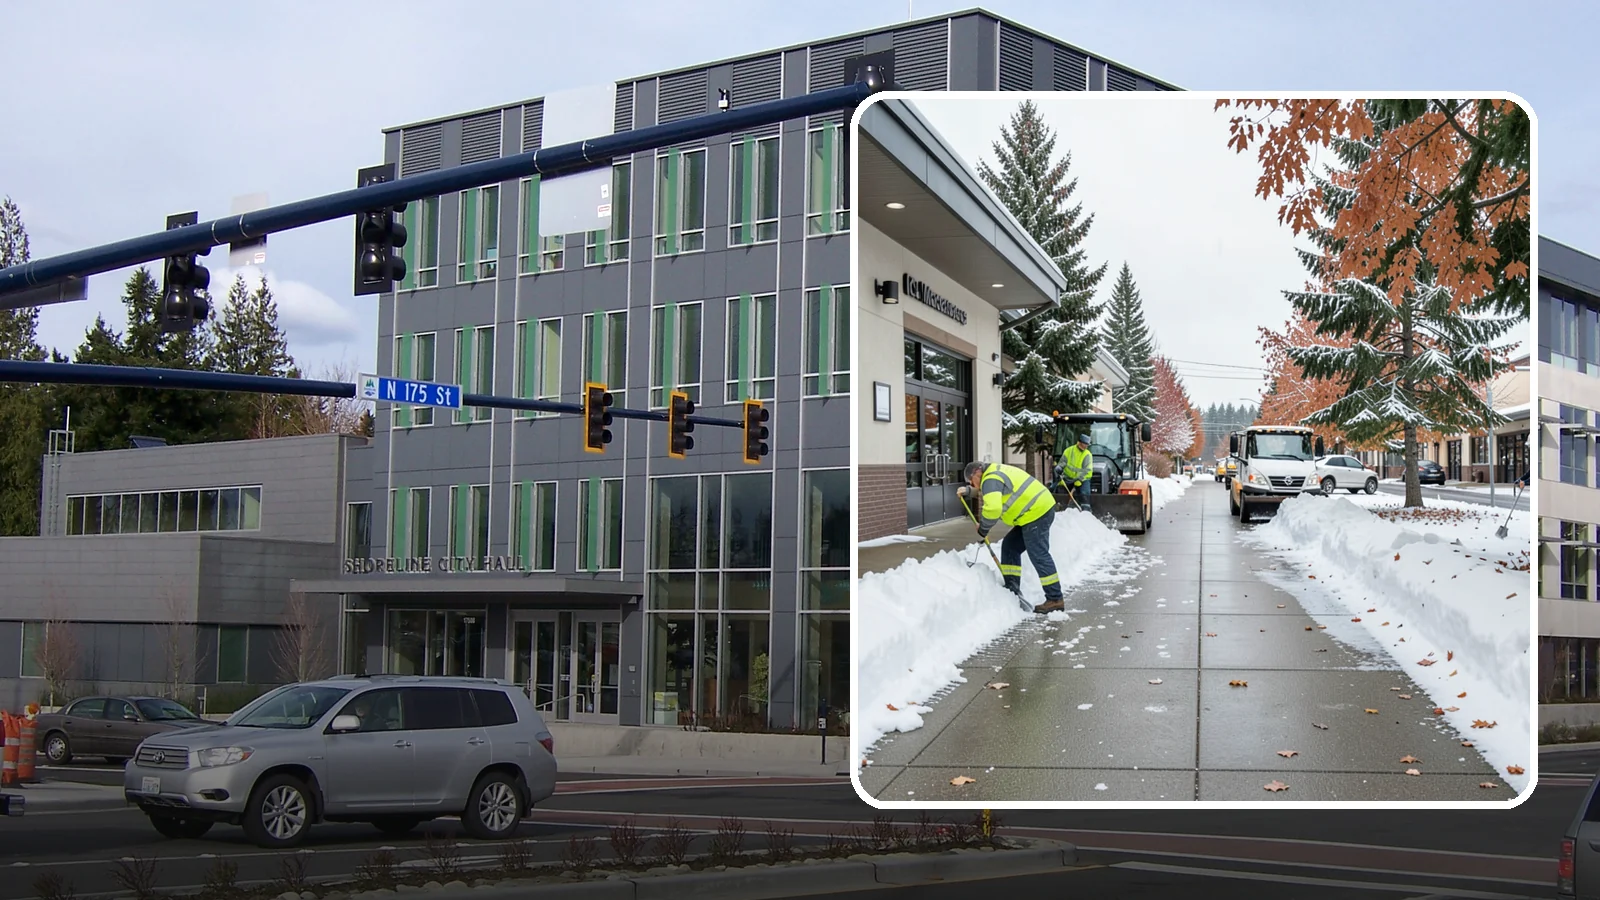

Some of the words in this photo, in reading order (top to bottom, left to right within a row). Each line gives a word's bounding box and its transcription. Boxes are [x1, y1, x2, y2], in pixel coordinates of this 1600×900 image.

[387, 380, 396, 400] N
[405, 382, 427, 403] 175
[436, 386, 451, 406] St
[344, 556, 431, 574] SHORELINE
[438, 556, 475, 572] CITY
[484, 555, 525, 572] HALL
